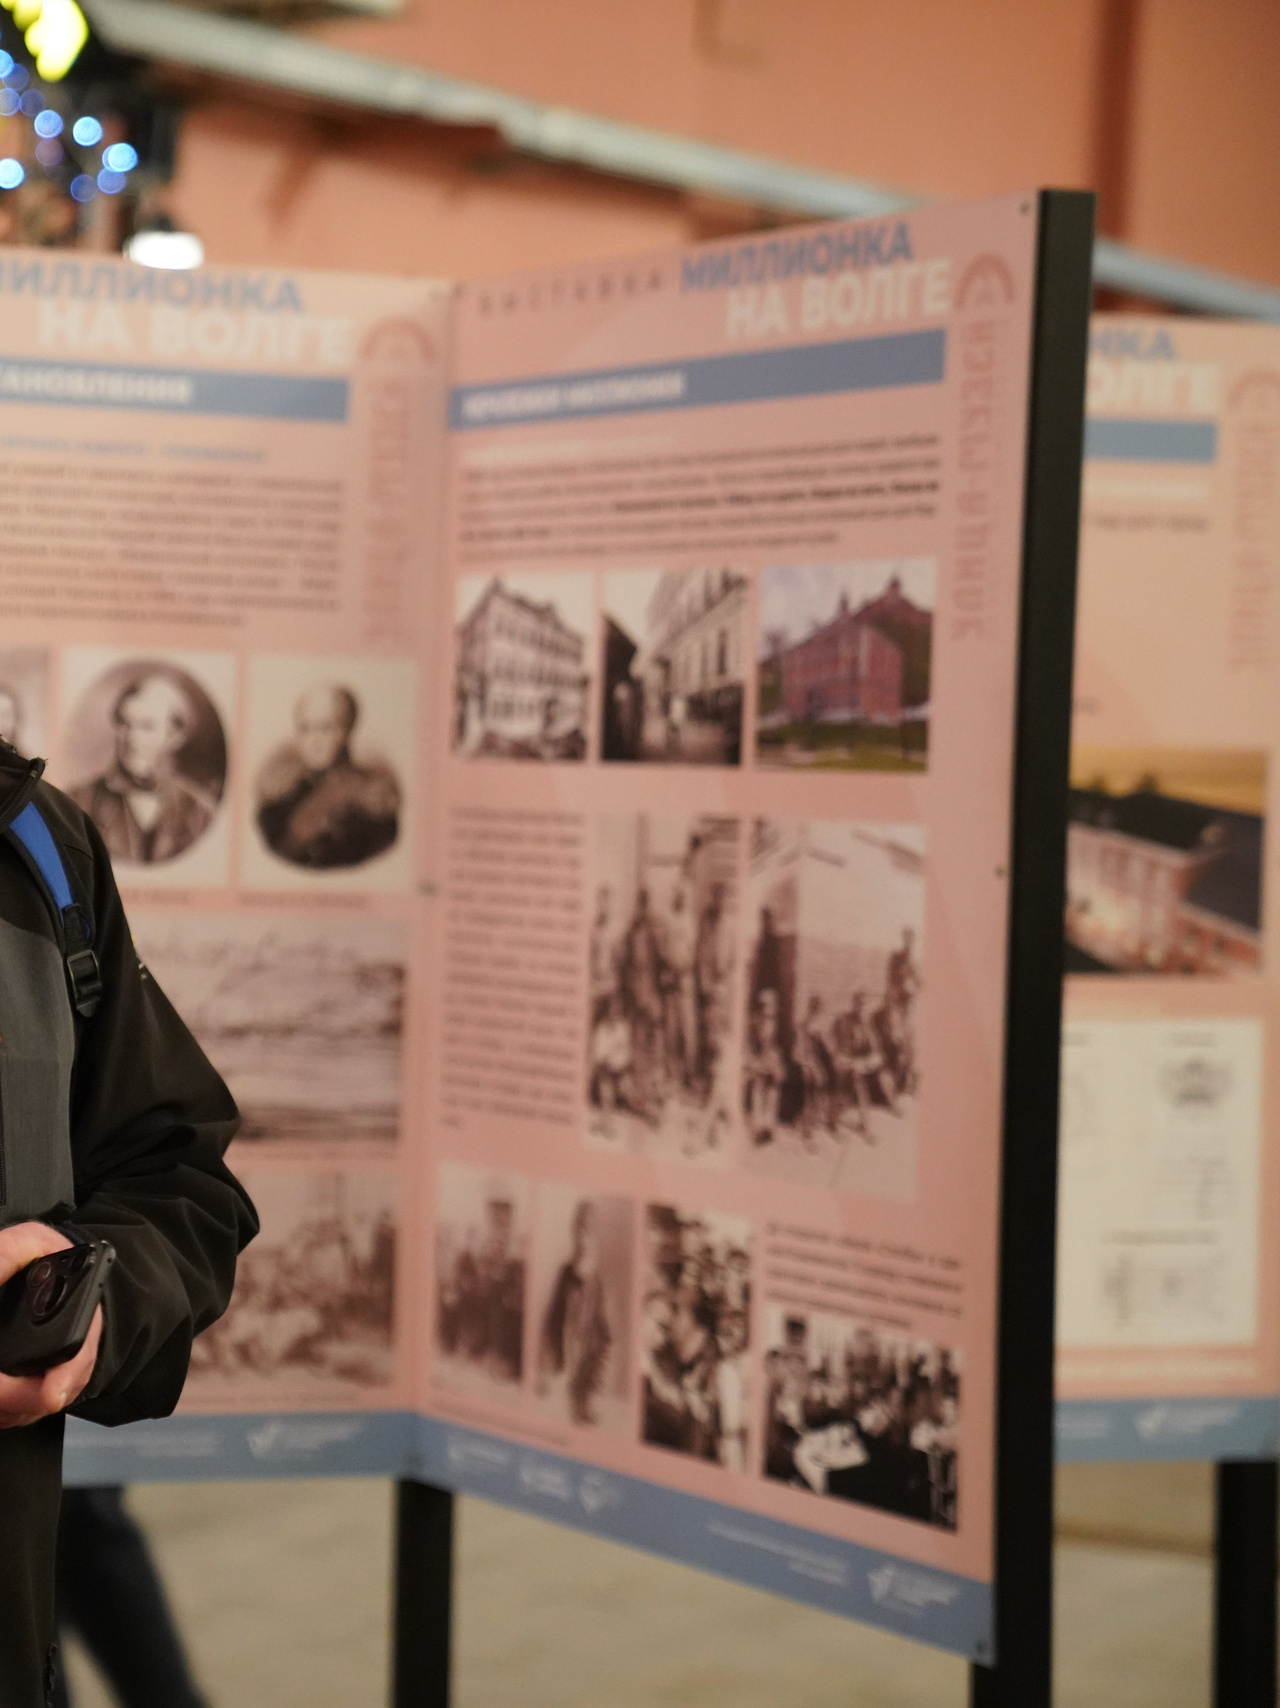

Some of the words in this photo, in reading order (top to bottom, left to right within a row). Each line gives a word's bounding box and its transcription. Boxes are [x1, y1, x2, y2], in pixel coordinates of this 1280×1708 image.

[680, 221, 913, 294] МИЛЛИОНКА
[36, 297, 130, 348] НА
[150, 303, 355, 367] ВОЛГЕ
[725, 283, 791, 340] НА
[801, 256, 952, 332] ВОЛГЕ
